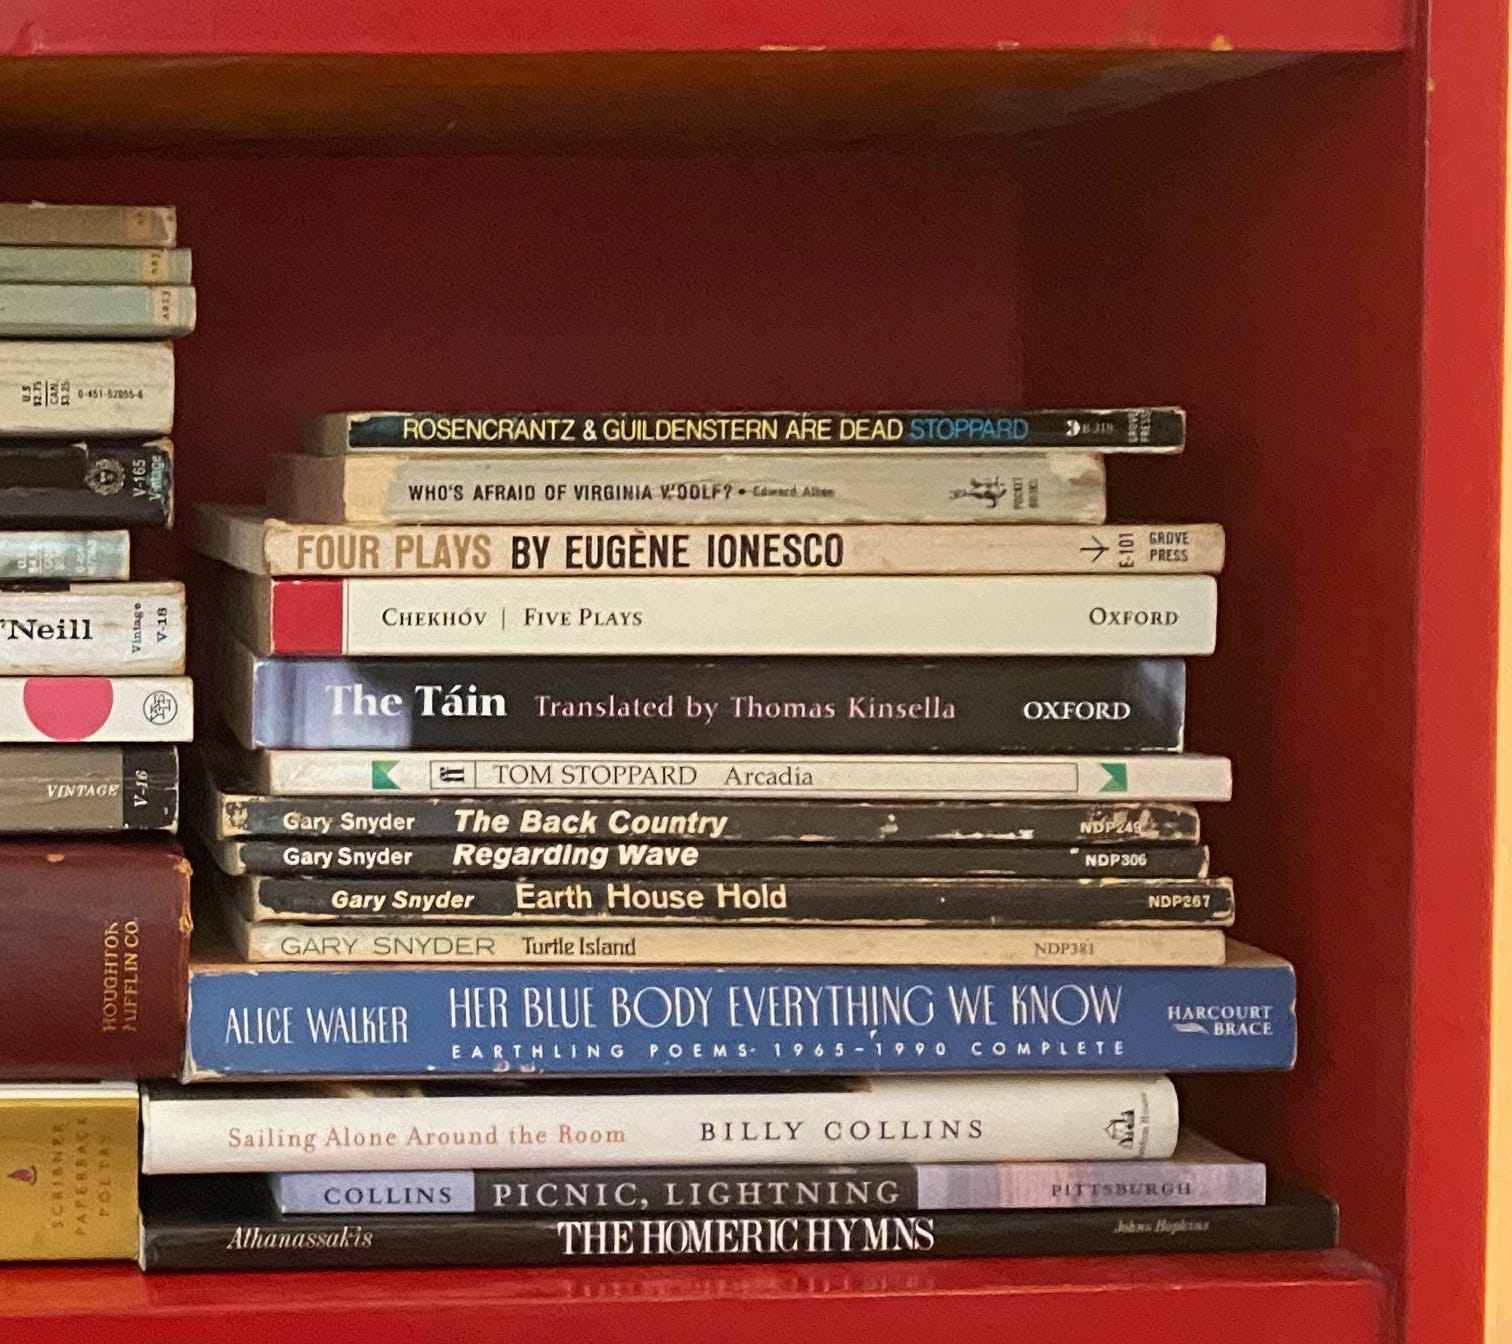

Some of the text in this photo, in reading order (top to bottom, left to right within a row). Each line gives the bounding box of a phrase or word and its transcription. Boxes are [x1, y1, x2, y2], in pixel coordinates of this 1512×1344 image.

[403, 419, 1029, 441] ROSENCRANTZ & GUILDENSTERN ARE DEAD STOPPARD
[325, 685, 955, 724] The Táin Translated by Thomas Kinsella
[1023, 701, 1130, 720] OXFORD
[493, 764, 813, 786] TOM STOPPARD Arcadia
[283, 809, 727, 840] Gary Snyder The Back Country
[332, 883, 787, 911] Gary Snyder Earth House Hold
[449, 984, 1122, 1029] HER BLUE BODY EVERYTHING WE KNOW
[226, 1006, 408, 1044] ALICE WALKER
[557, 1217, 935, 1256] THE HOMERIC HYMNS
